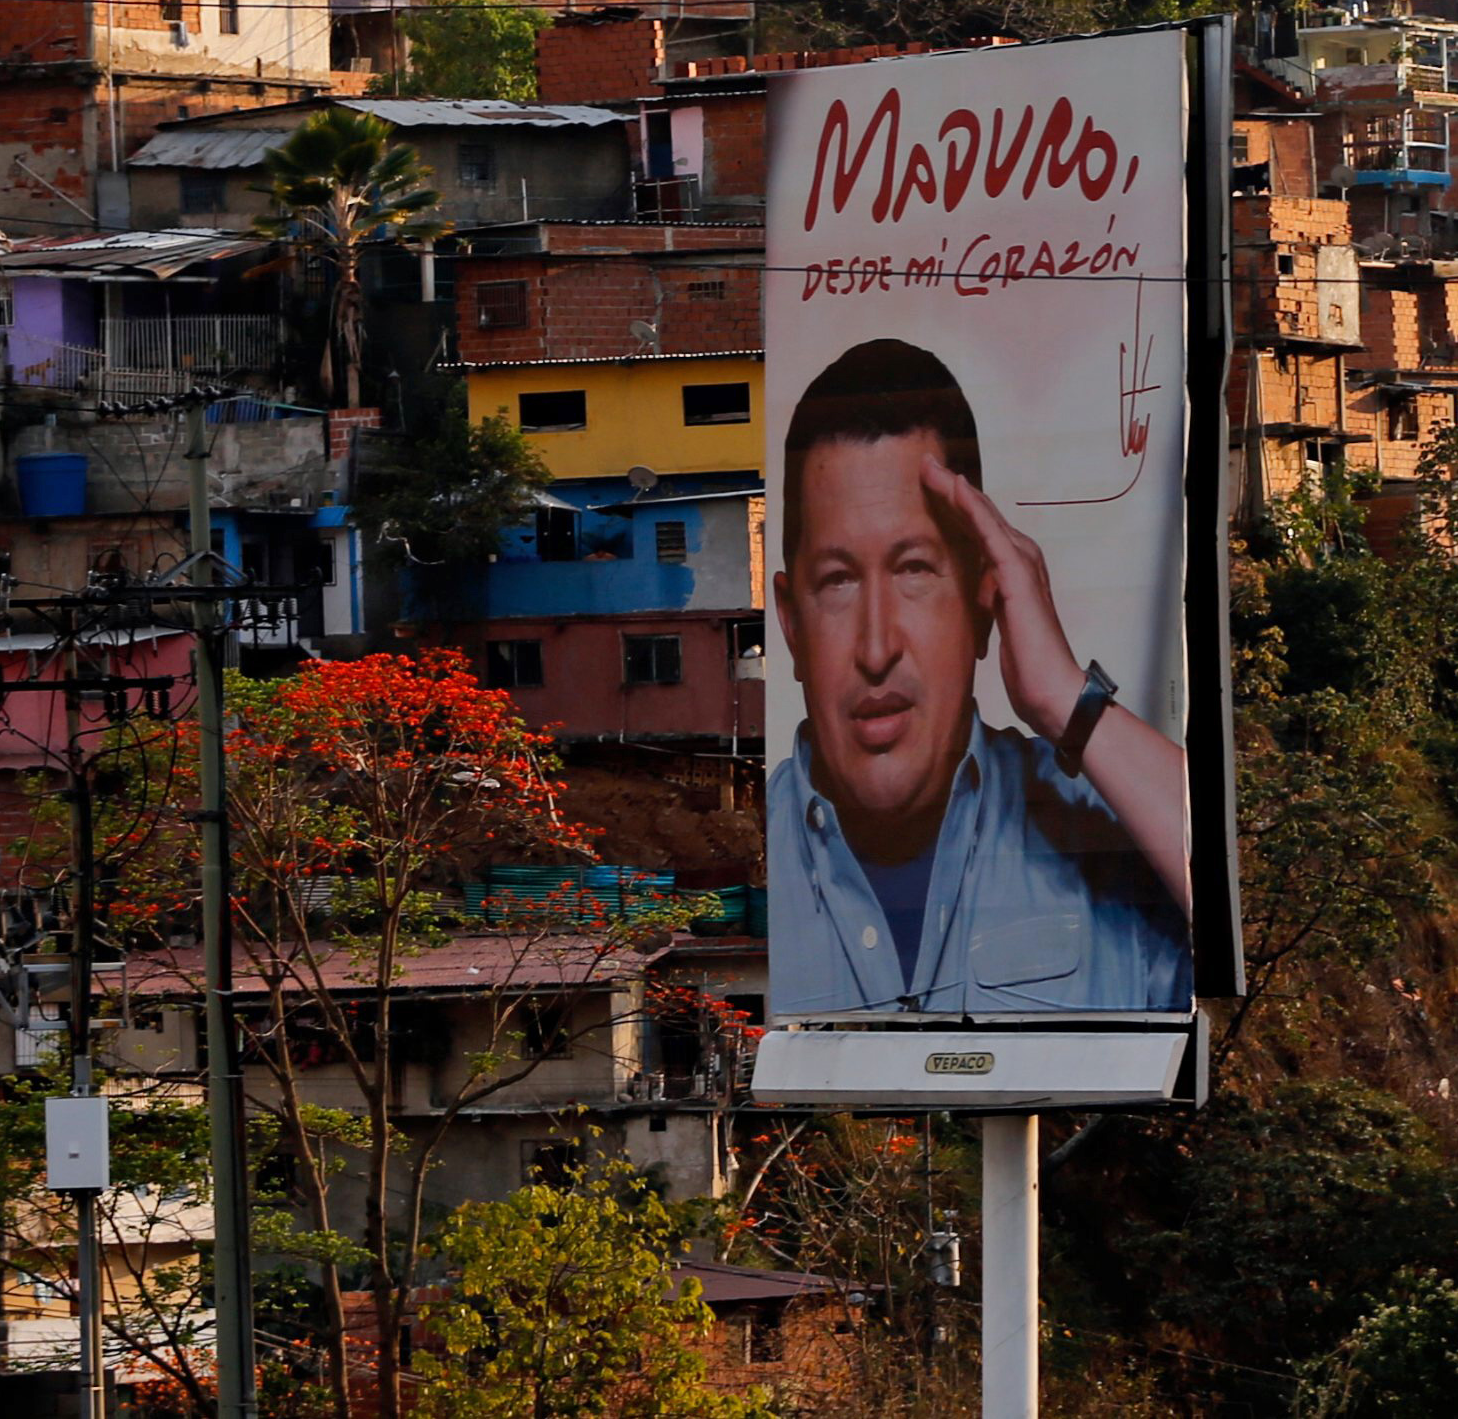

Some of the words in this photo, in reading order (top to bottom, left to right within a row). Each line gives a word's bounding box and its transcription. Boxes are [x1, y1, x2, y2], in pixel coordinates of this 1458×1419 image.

[805, 87, 1140, 232] MADURO,
[802, 255, 893, 301] DESDE
[933, 1056, 986, 1070] VEPACO
